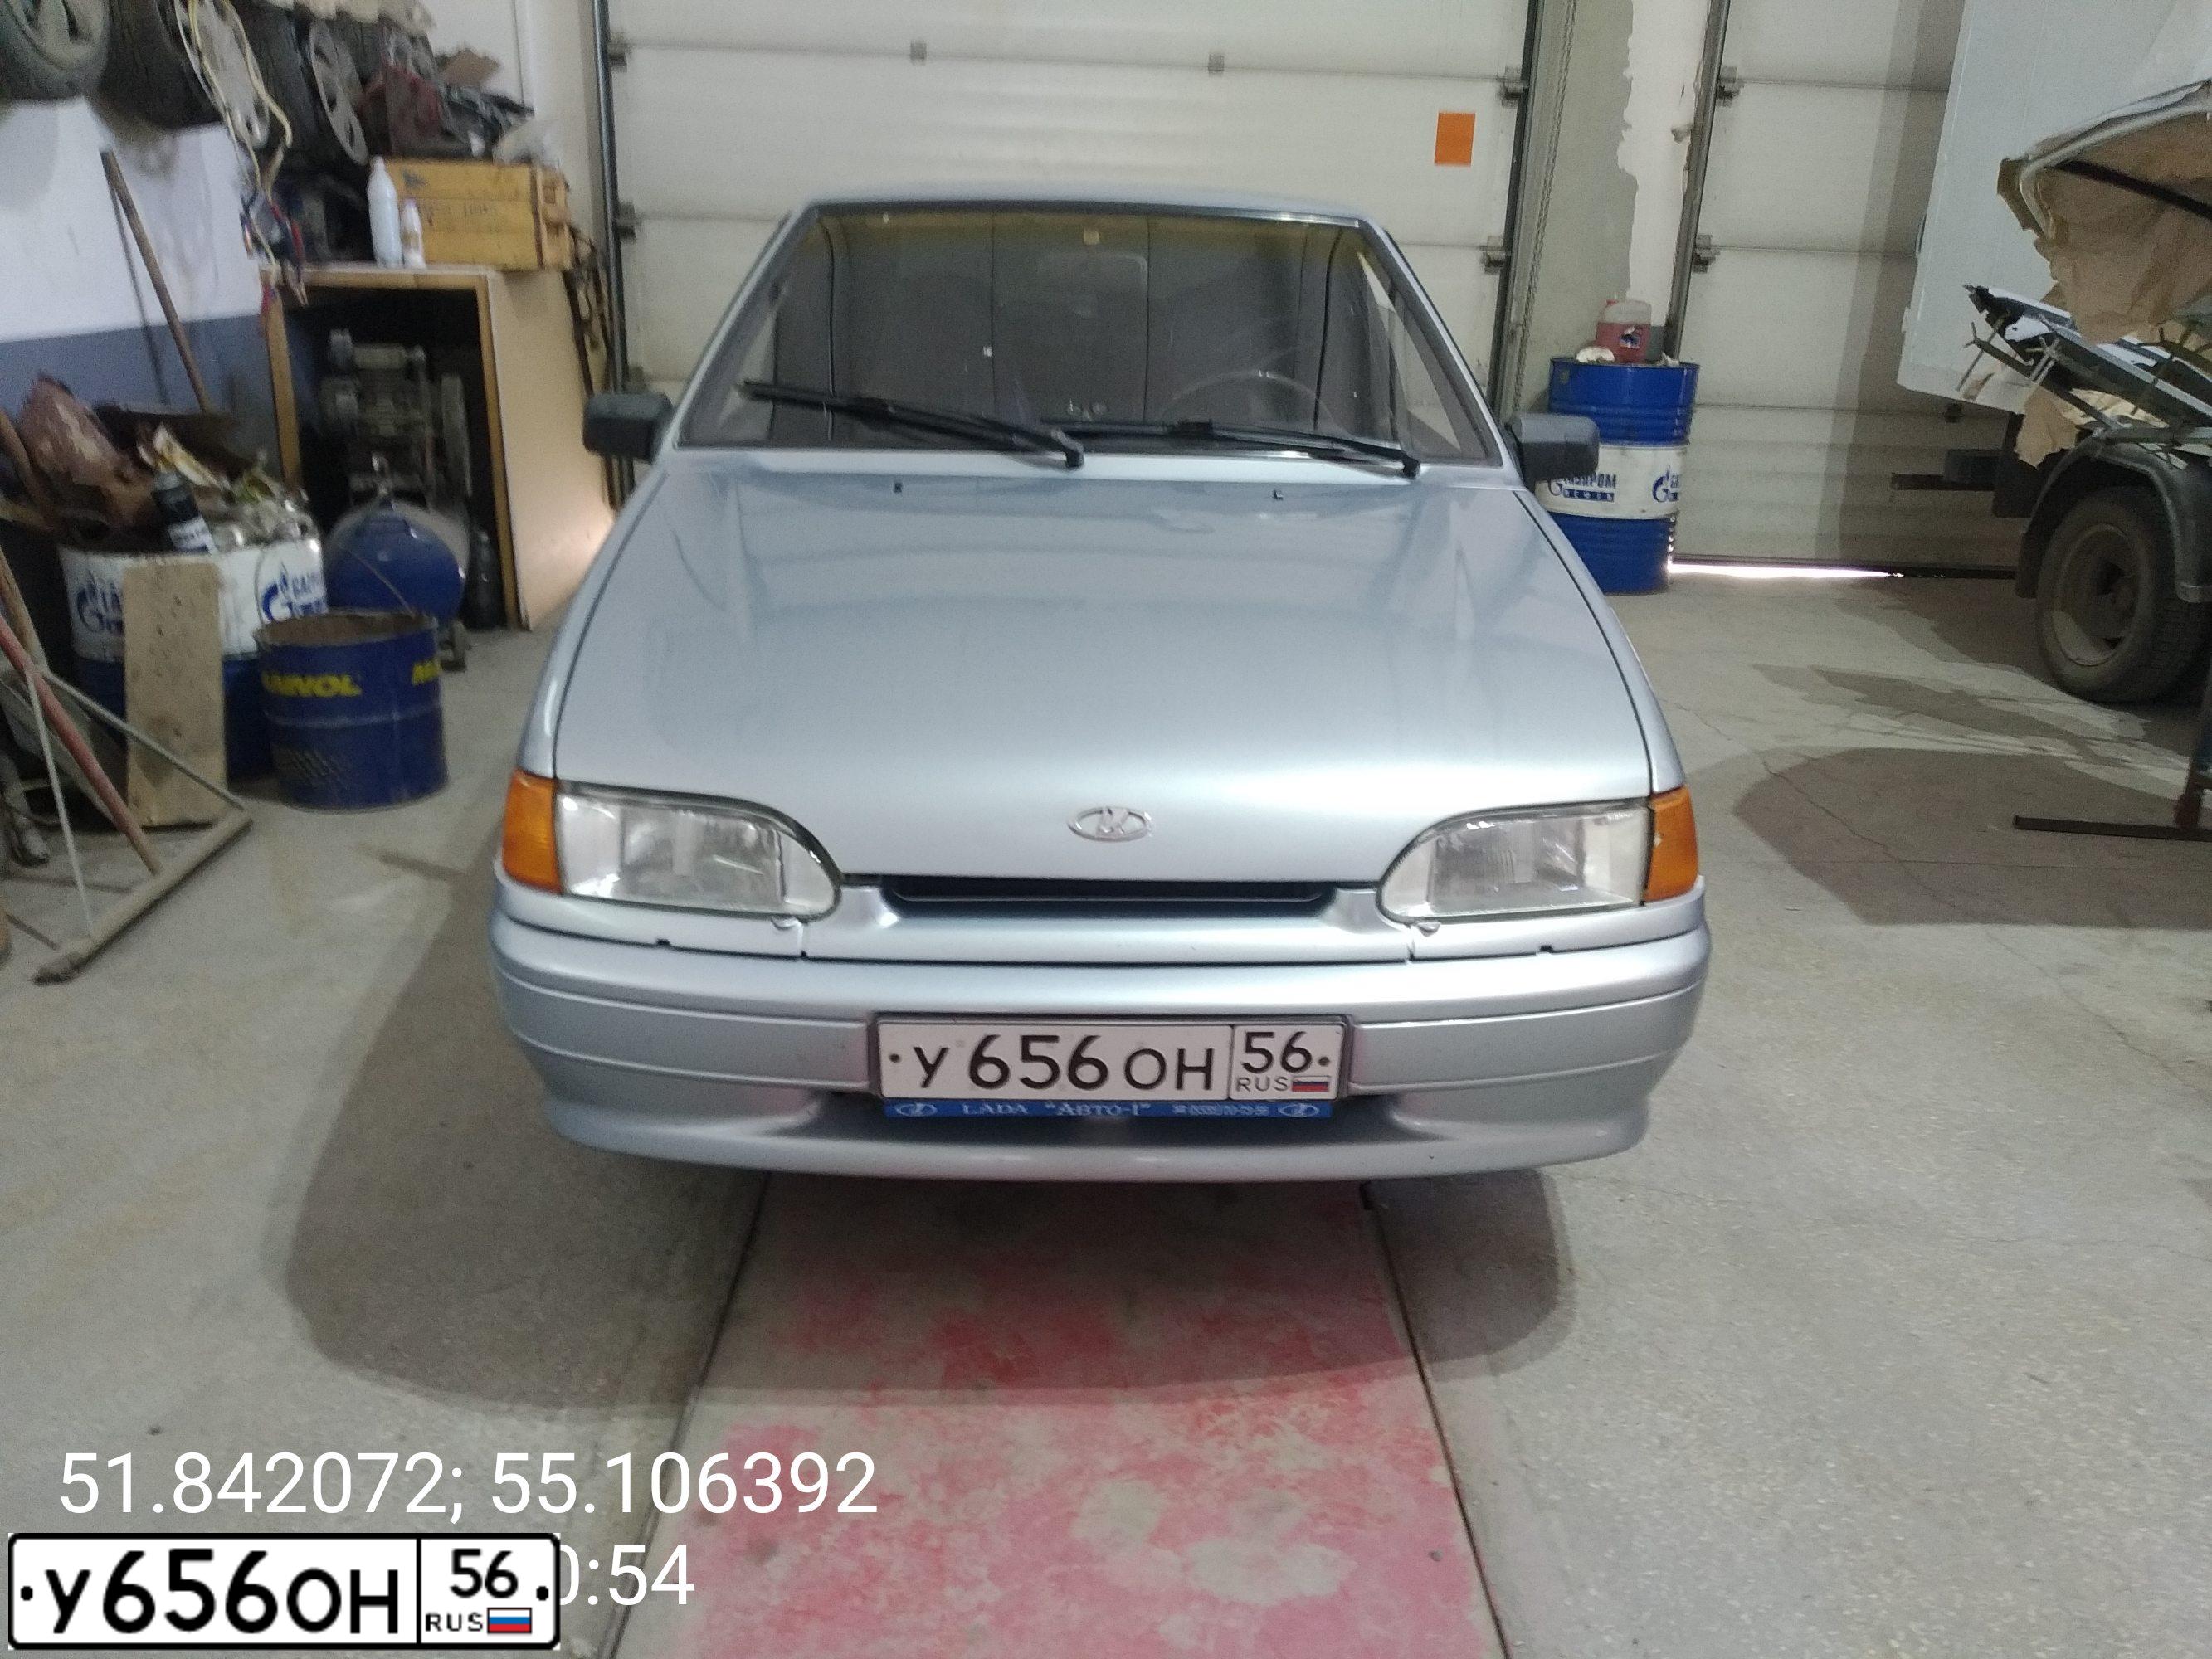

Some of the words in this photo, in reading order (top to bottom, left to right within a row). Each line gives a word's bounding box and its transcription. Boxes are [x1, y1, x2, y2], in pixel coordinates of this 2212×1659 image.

[1241, 1031, 1313, 1074] 56
[1235, 1077, 1289, 1092] RUS
[962, 1102, 1028, 1116] LADA
